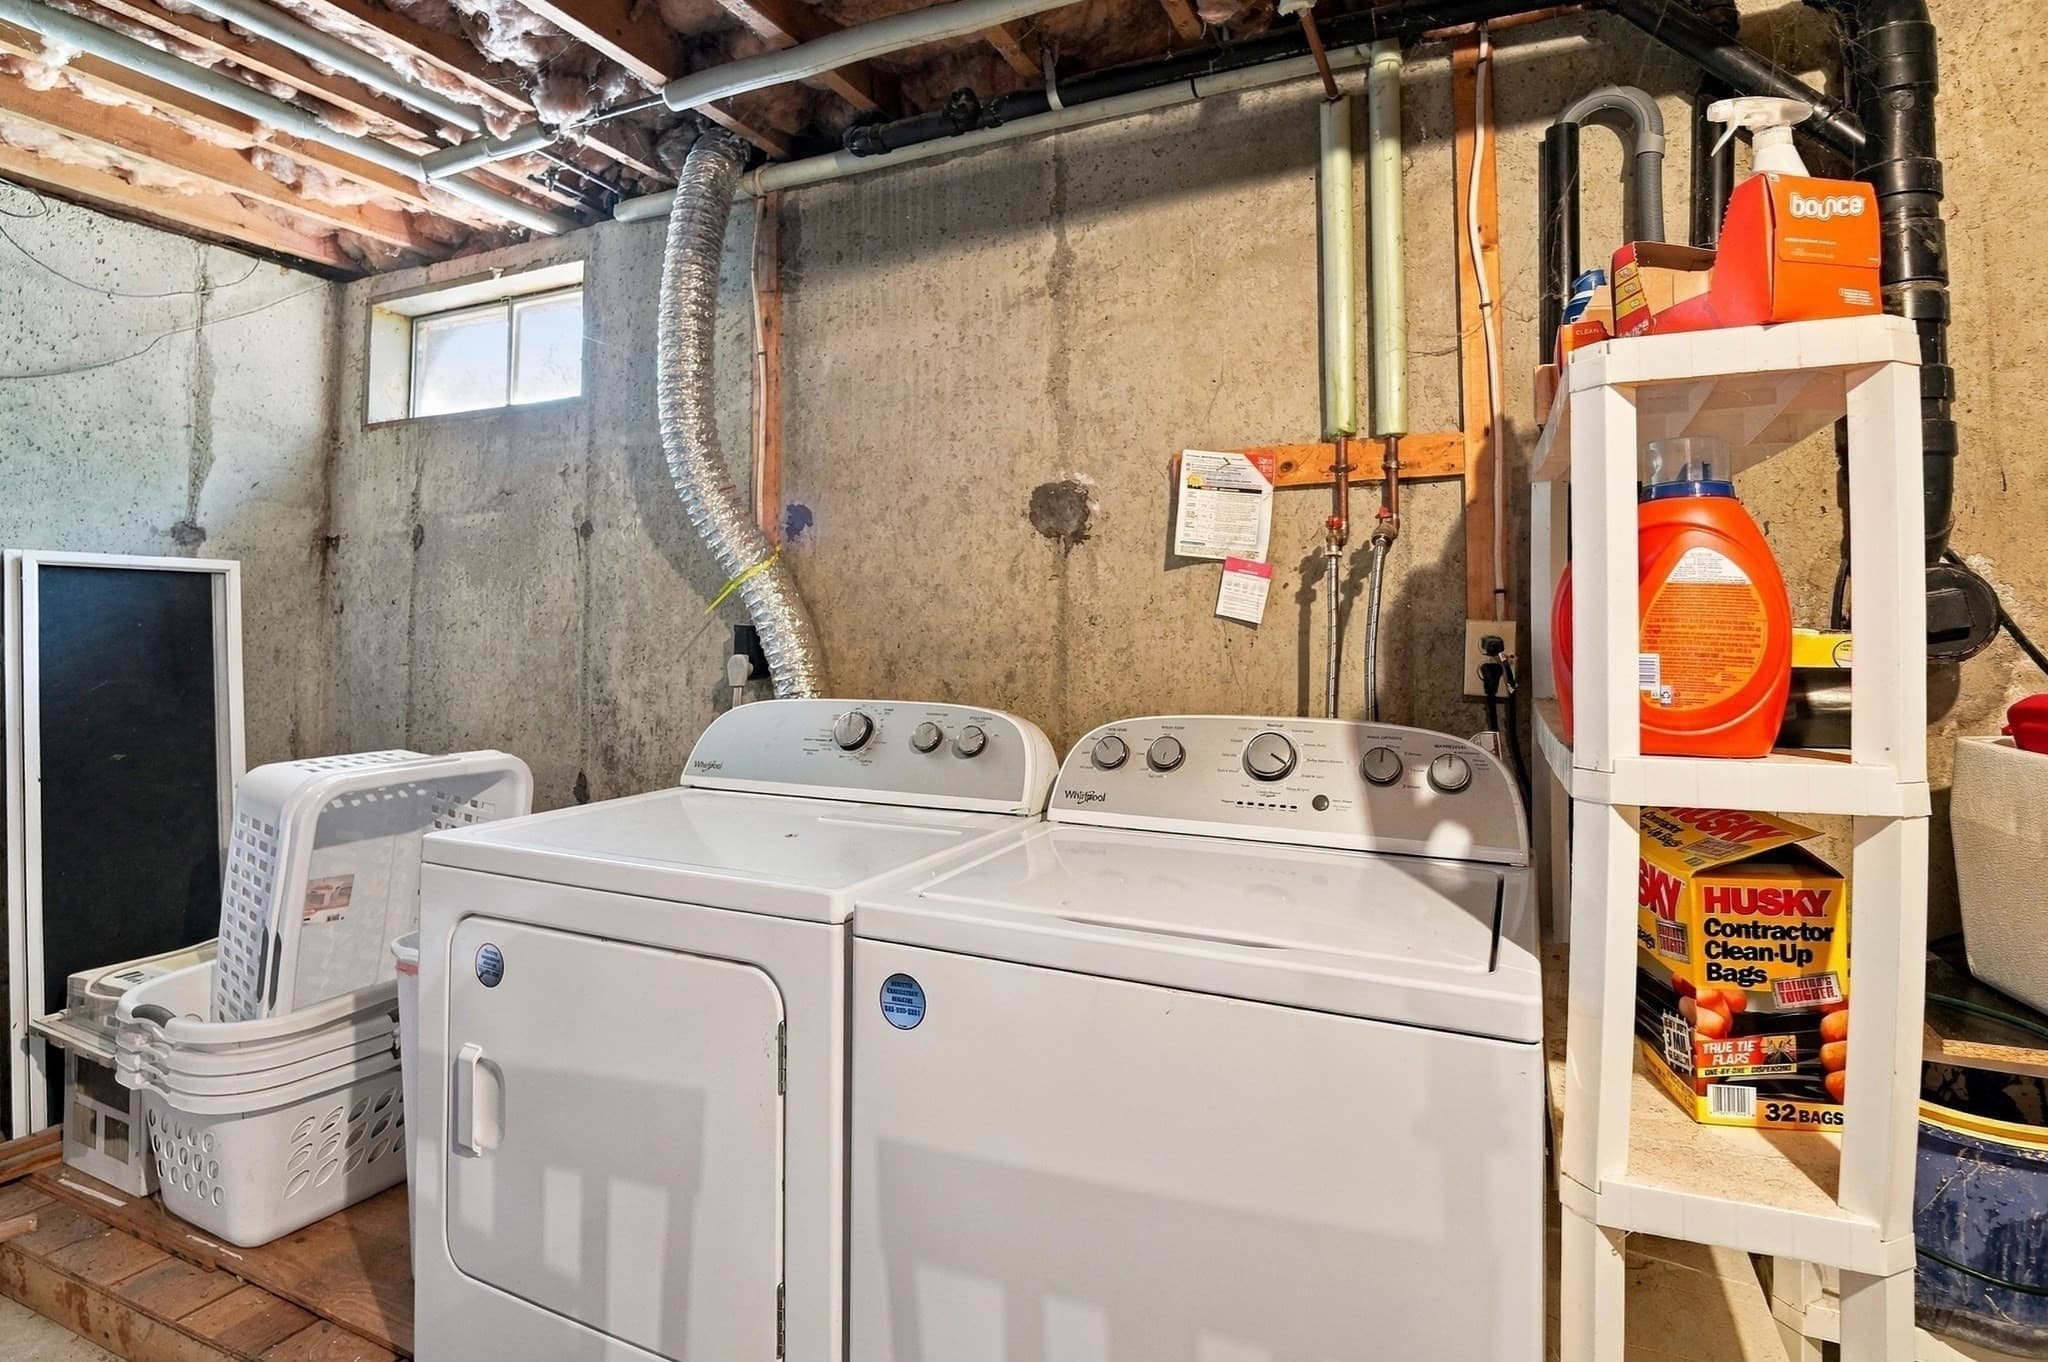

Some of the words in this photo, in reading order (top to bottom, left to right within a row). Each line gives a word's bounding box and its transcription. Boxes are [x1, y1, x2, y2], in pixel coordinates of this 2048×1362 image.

[1790, 192, 1866, 221] bounce
[1064, 789, 1107, 805] Whirlpool
[1703, 886, 1832, 918] HUSKY
[1703, 917, 1834, 942] Contractor
[1704, 940, 1814, 968] Clean-Up
[1706, 962, 1768, 988] Bags
[1702, 1042, 1733, 1054] TRUE
[1736, 1040, 1758, 1052] TIE
[1712, 1053, 1750, 1065] FLAPS
[1764, 1102, 1797, 1123] 32
[1798, 1109, 1844, 1126] BAGS
